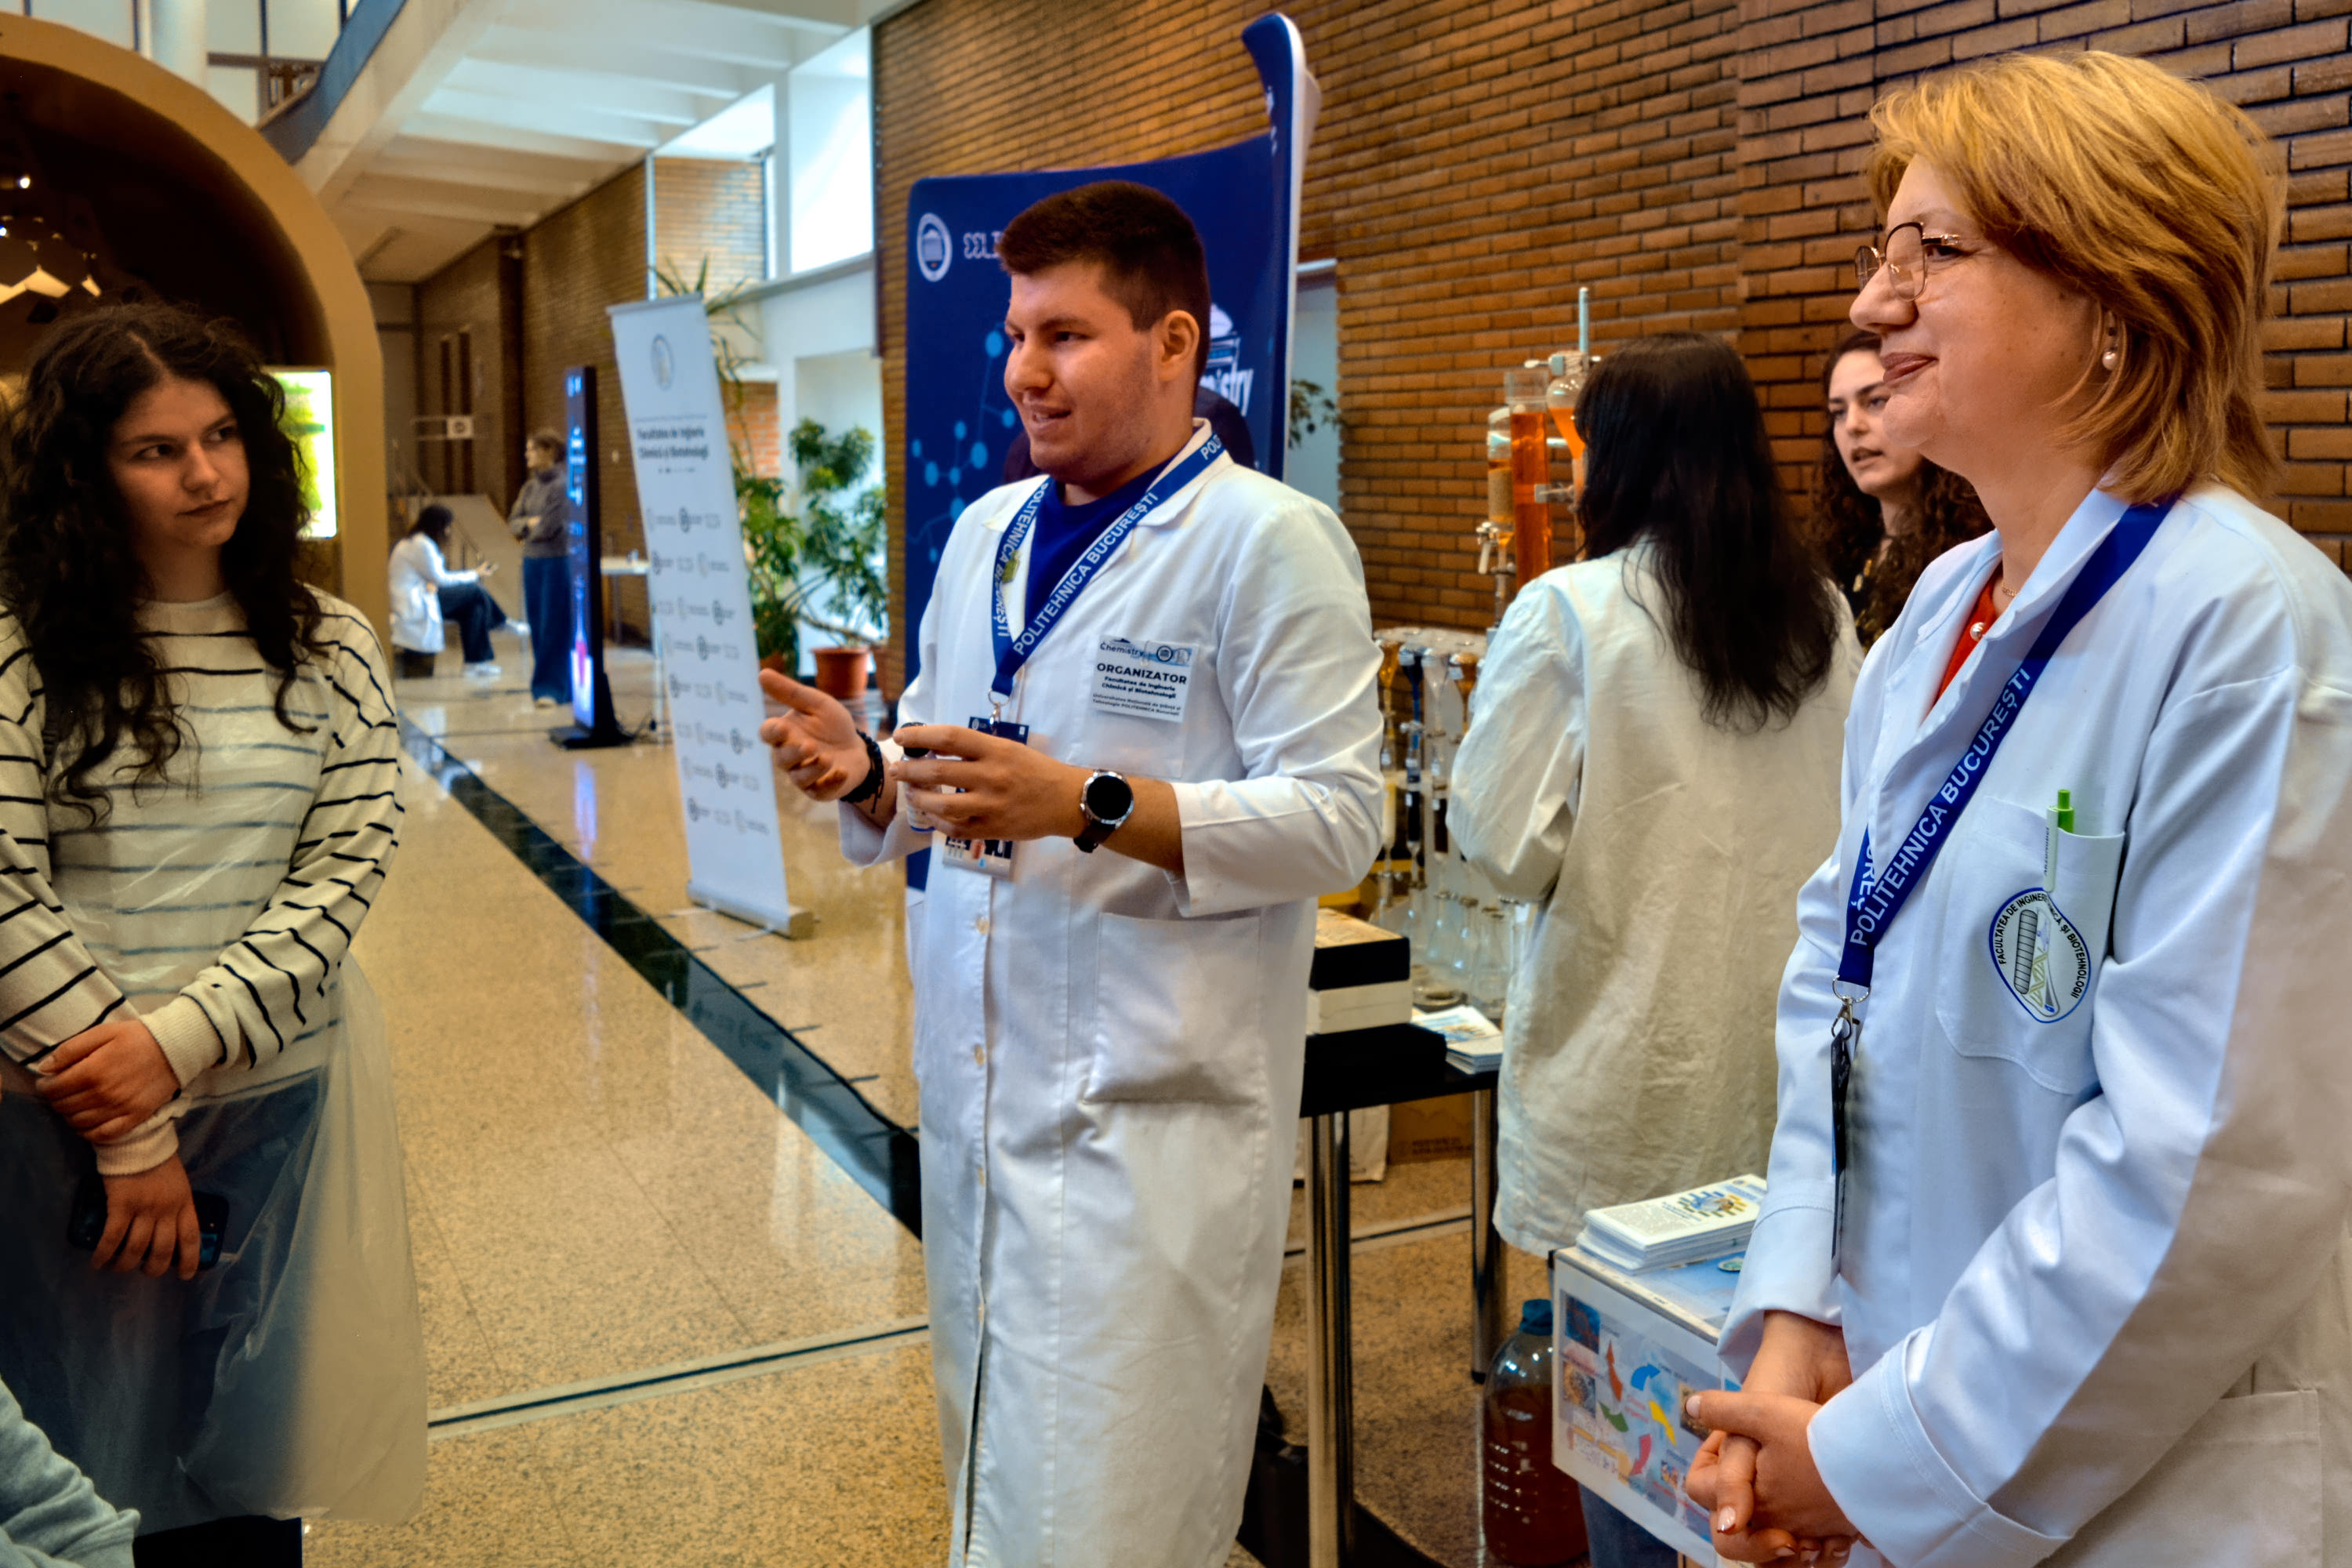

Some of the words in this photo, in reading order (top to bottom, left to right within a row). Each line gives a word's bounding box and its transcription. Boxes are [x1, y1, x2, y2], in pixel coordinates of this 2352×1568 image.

[1013, 564, 1092, 655] POLITEHNICA
[1087, 491, 1159, 565] BUCUREȘTI
[1097, 662, 1187, 684] ORGANIZATOR
[1849, 804, 1948, 946] POLITEHNICA
[1940, 667, 2031, 804] BUCUREȘTI
[1994, 915, 2009, 965] FACULTATEA
[2006, 903, 2019, 916] DE
[2067, 934, 2087, 1000] BIOTEHNOLOGII
